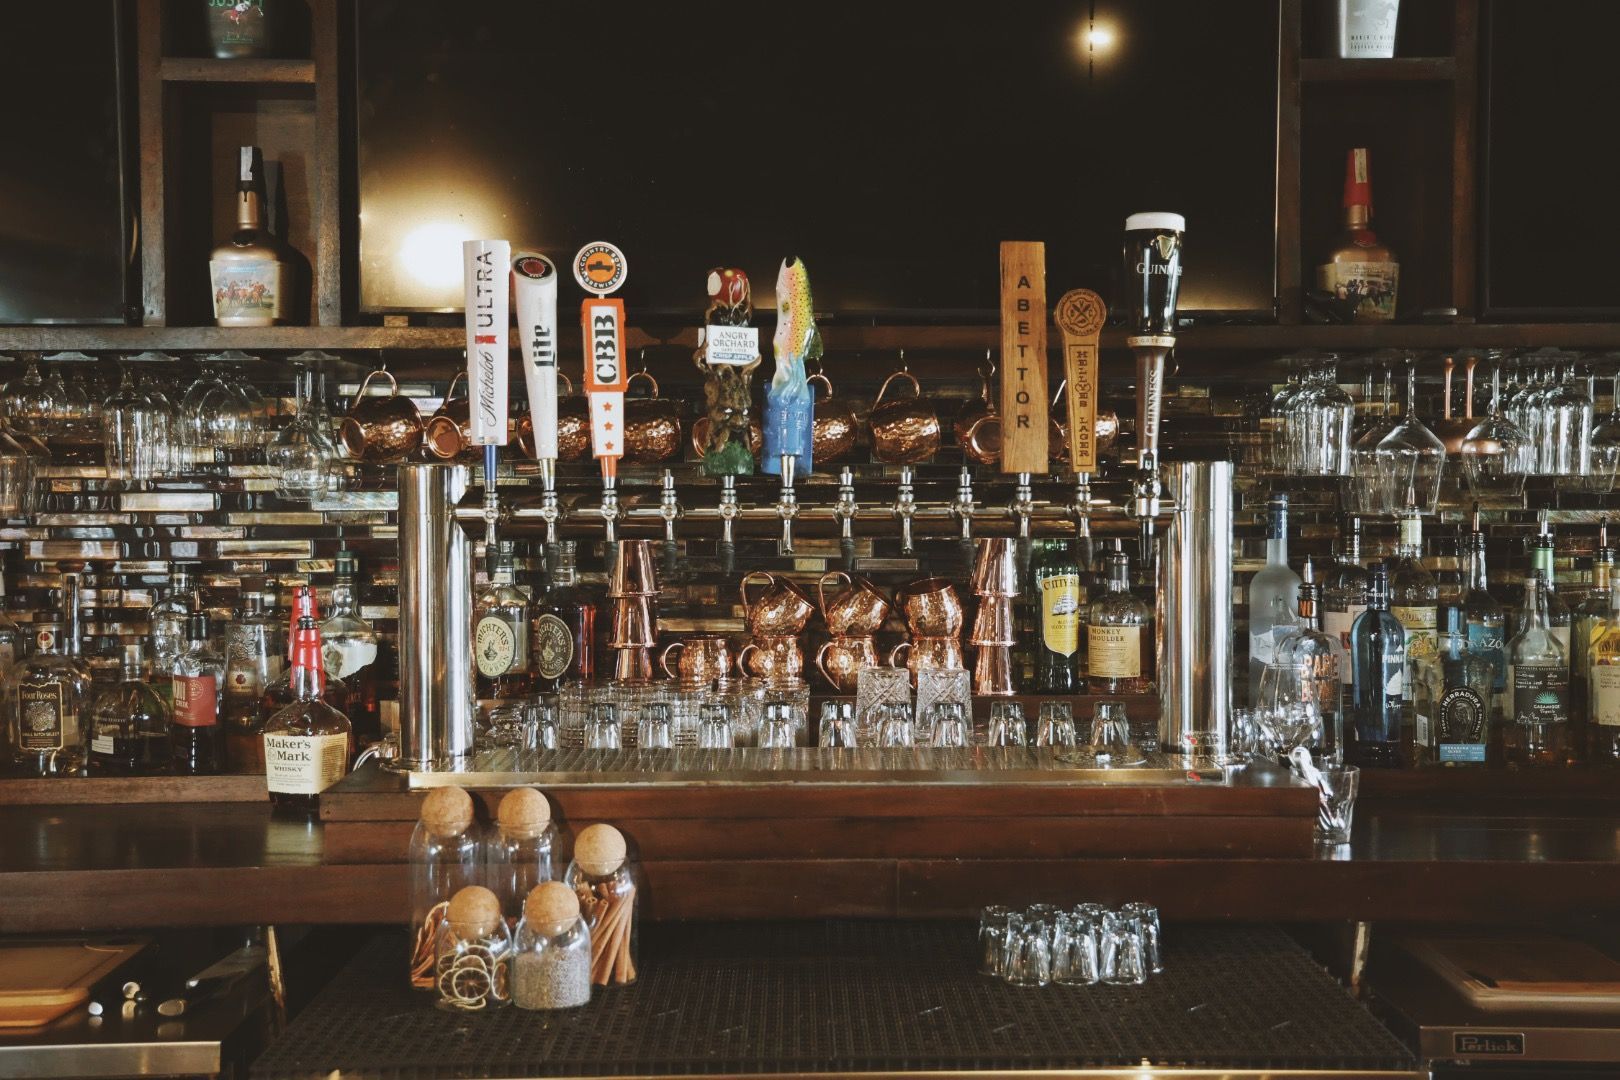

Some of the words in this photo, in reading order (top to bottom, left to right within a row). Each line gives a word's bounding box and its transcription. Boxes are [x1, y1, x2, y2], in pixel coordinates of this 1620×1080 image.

[580, 246, 609, 267] COUNTRY
[610, 252, 621, 267] BOY
[476, 250, 493, 328] ULTRA
[586, 276, 618, 289] BREWING
[713, 339, 755, 348] ORCHARD
[719, 331, 749, 340] ANGRY
[594, 314, 617, 383] CBB
[1016, 275, 1031, 428] ABETTOR
[480, 349, 497, 428] Michelob
[1145, 370, 1160, 437] GUINNESS
[1079, 416, 1089, 457] LAGER
[36, 690, 57, 700] Roses
[1442, 691, 1481, 708] HERRADURA
[266, 738, 311, 749] Maker's
[277, 751, 312, 761] Mark
[1461, 1037, 1518, 1051] Perlick
